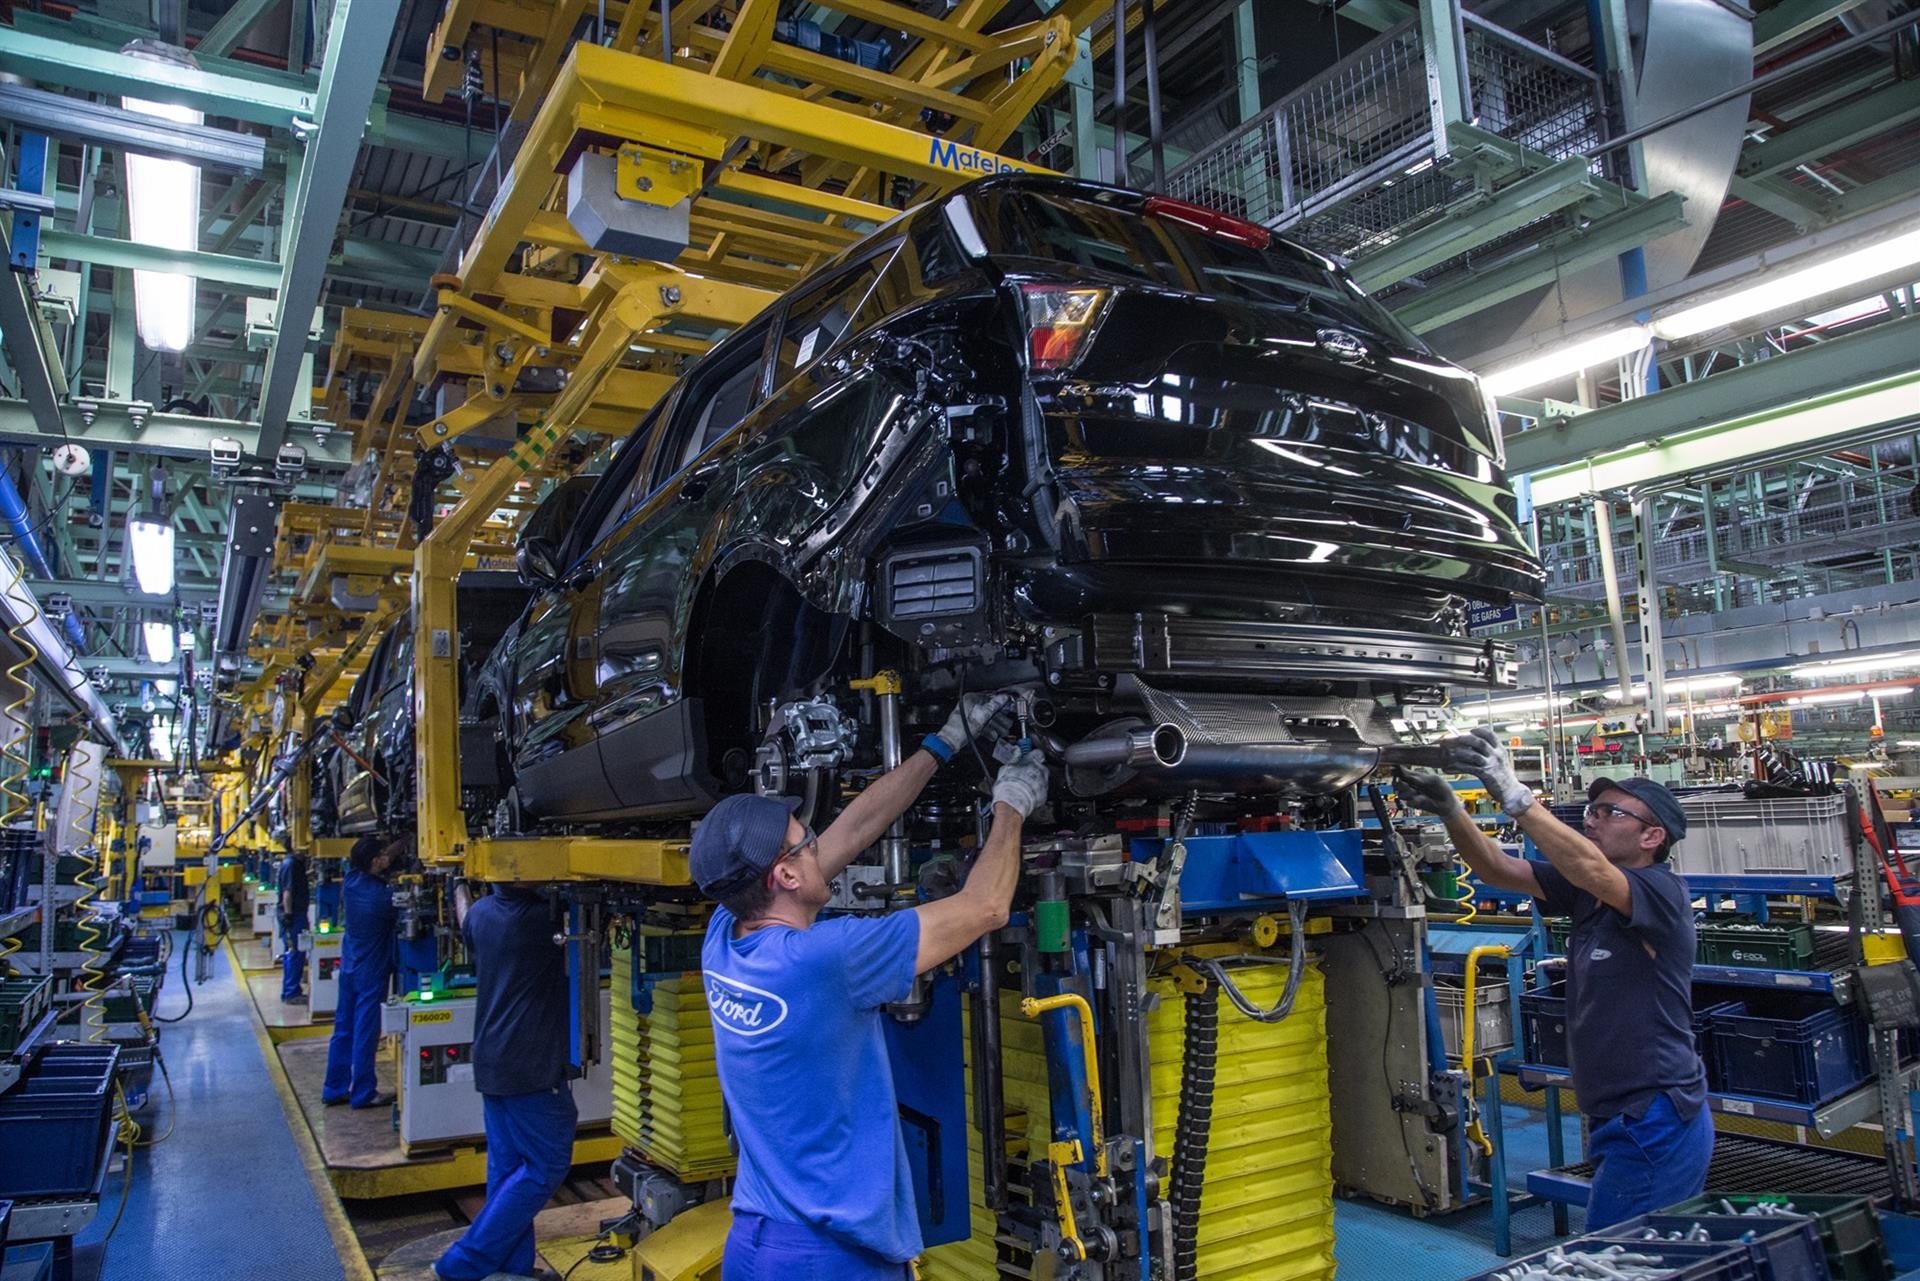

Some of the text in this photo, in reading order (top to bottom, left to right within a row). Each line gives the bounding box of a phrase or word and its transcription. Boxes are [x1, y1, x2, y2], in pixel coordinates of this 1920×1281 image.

[1471, 608, 1501, 624] DE GAFAS
[708, 978, 764, 1028] Ford
